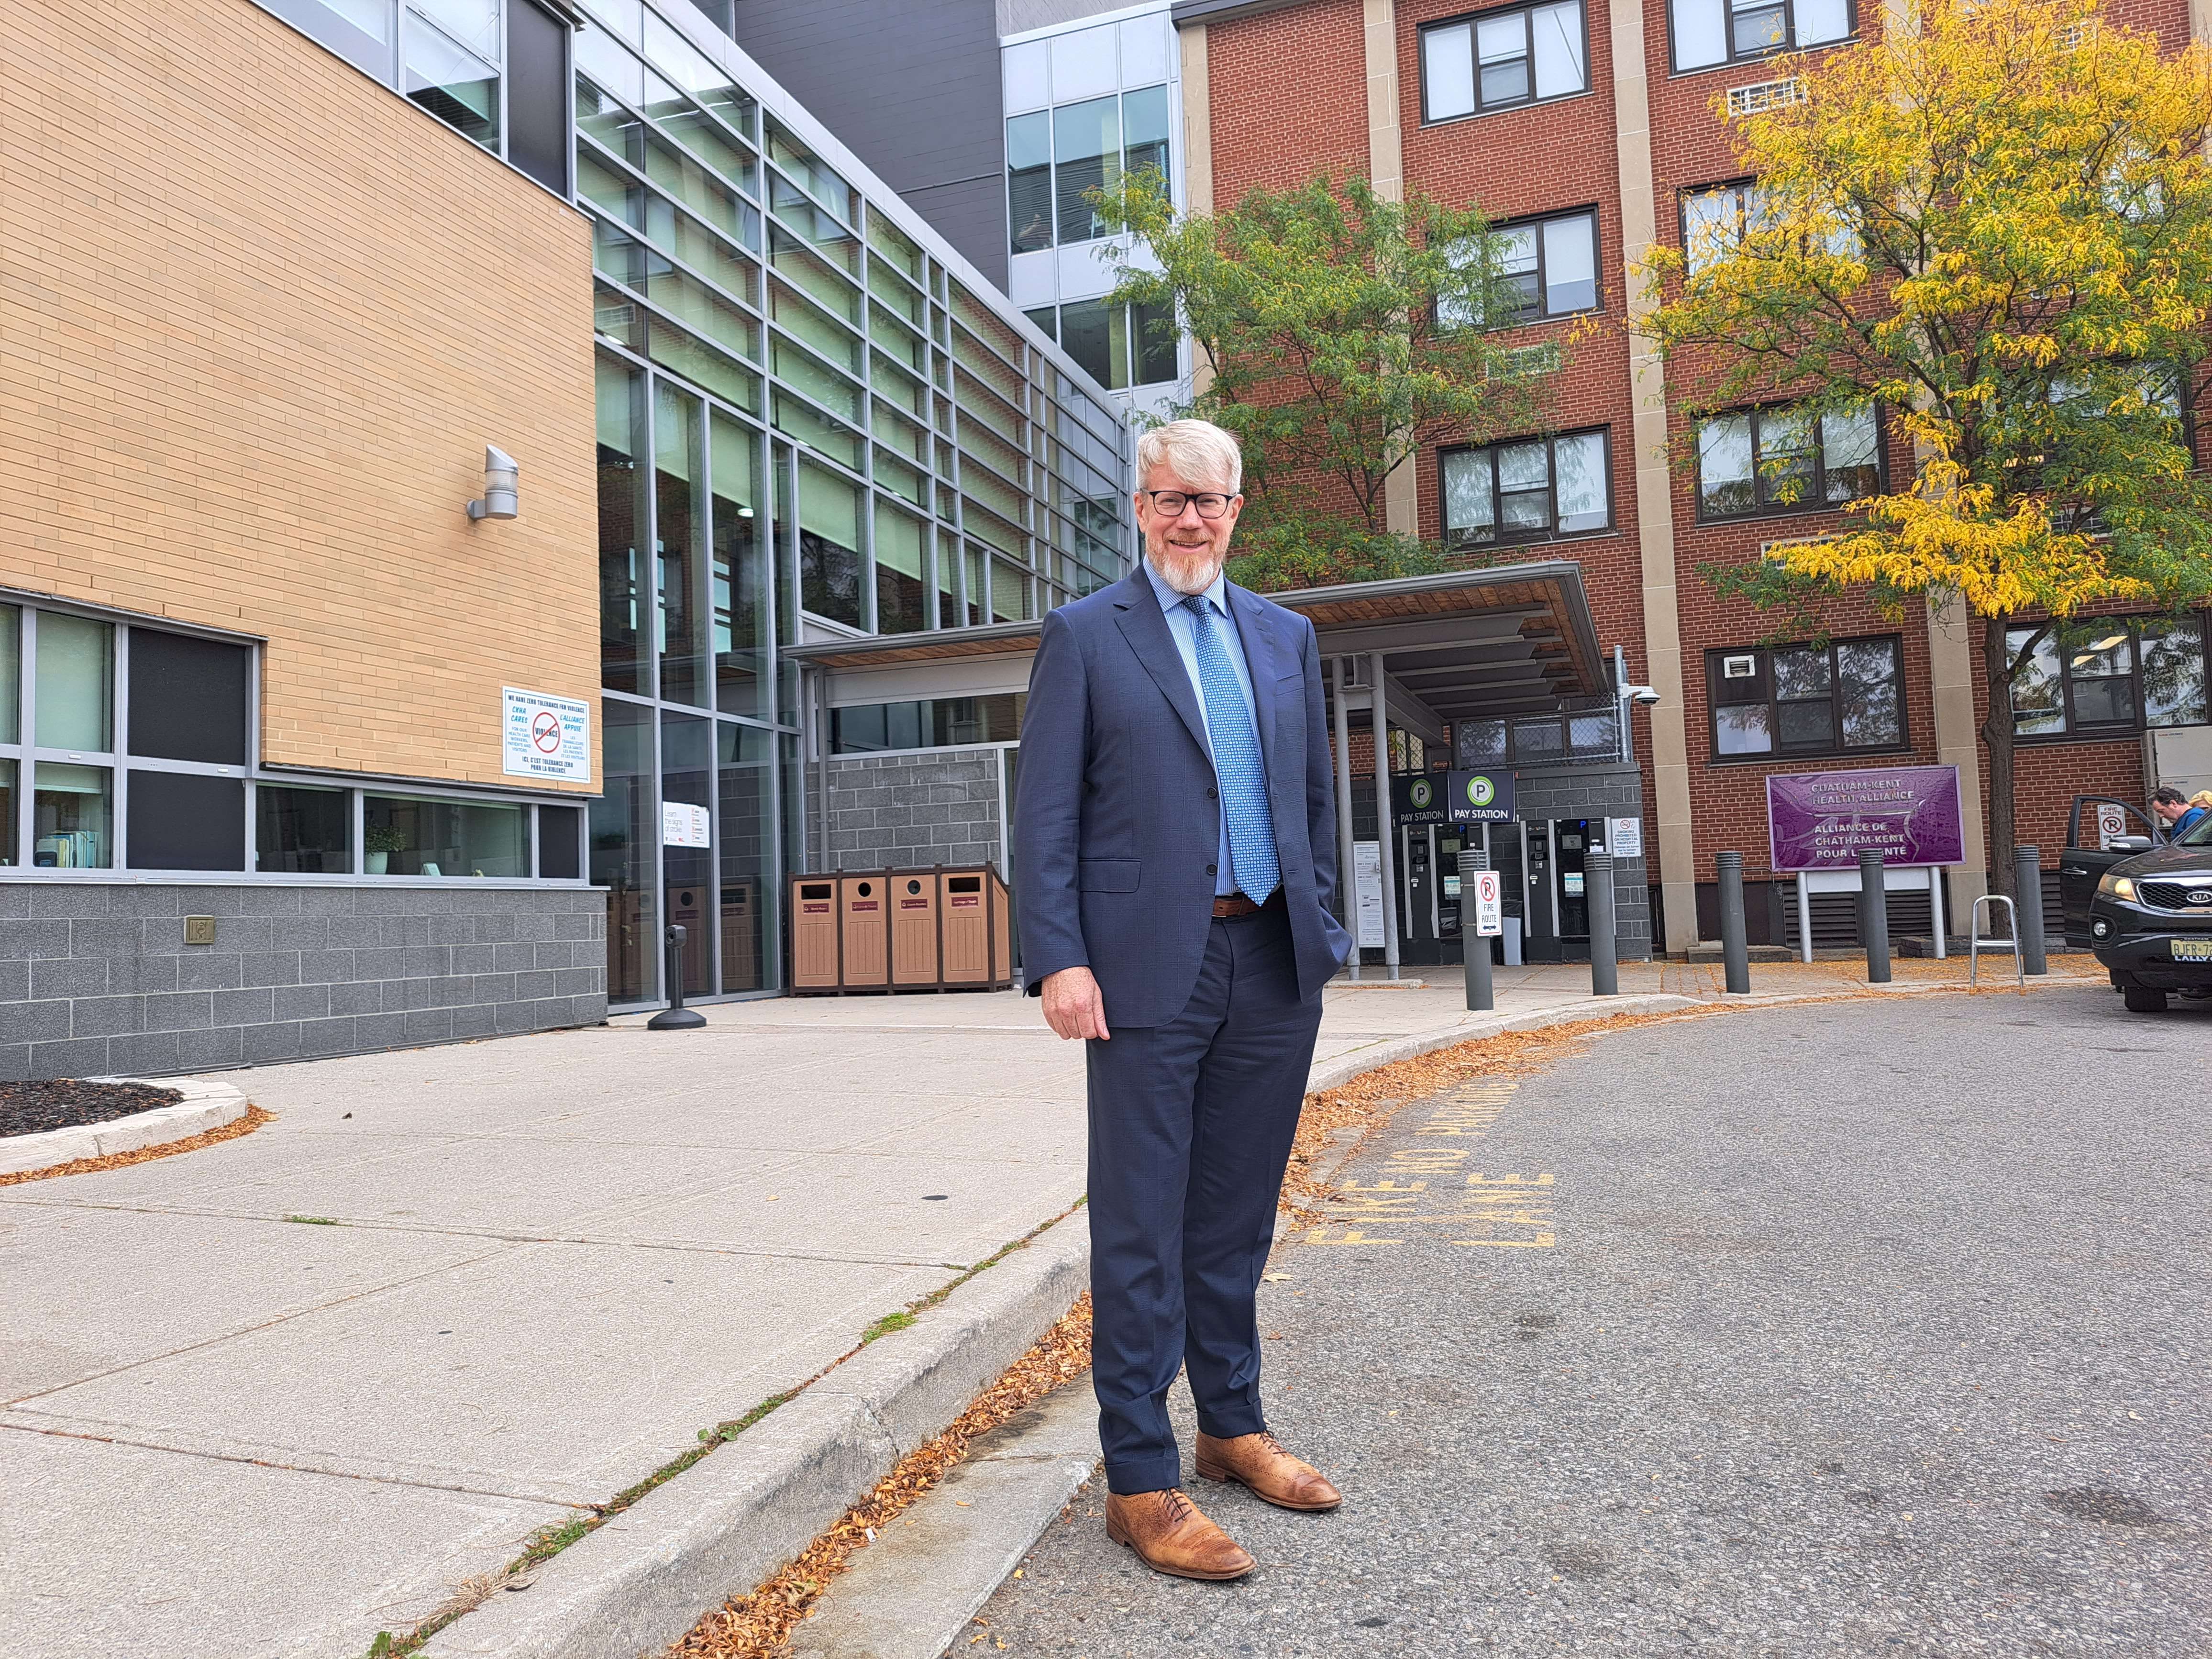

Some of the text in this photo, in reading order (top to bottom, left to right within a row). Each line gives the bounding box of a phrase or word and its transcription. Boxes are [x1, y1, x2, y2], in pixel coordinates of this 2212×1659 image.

[537, 700, 558, 708] TOLERANCE
[567, 705, 585, 713] VIOLENCE
[511, 715, 528, 723] CARES
[564, 723, 582, 732] APPUIE
[1417, 787, 1425, 800] P
[1476, 785, 1485, 797] P
[1859, 791, 1914, 802] ALLIANCE
[1401, 810, 1444, 822] PAY STATION
[1455, 809, 1508, 818] PAY STATION
[1580, 820, 1586, 829] P
[1814, 822, 1888, 833] ALLIANCE DE
[1815, 834, 1905, 846] CHATHAM-KENT
[1816, 849, 1847, 859] POUR
[1483, 903, 1494, 912] FIRE
[1482, 915, 1497, 923] ROUTE
[2174, 944, 2197, 955] BJFR
[1378, 1083, 1520, 1174] NO PARKING
[1447, 1173, 1555, 1247] LANE
